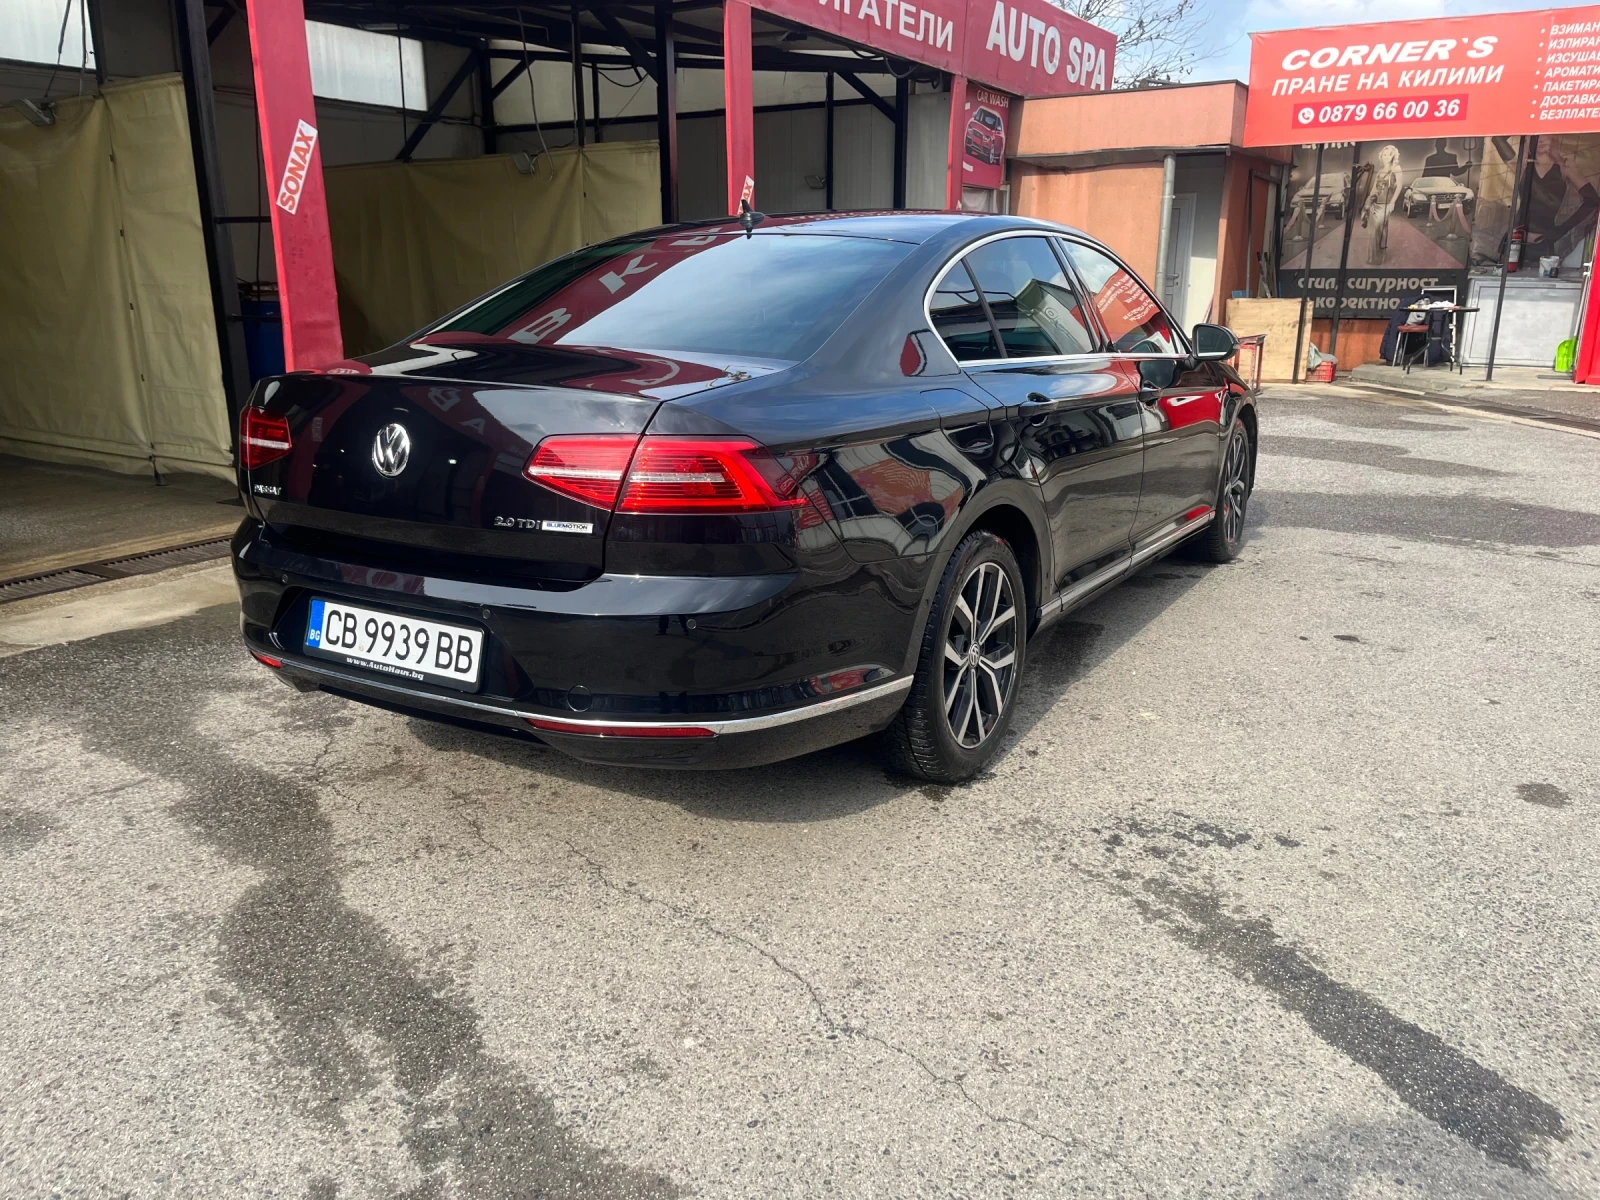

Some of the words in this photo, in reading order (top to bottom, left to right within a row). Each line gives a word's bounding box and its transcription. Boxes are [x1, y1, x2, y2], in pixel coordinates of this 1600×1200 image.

[986, 0, 1061, 75] AUTO
[1066, 36, 1106, 91] SPA
[1271, 74, 1351, 97] ПРАНЕ
[1356, 71, 1390, 91] НА
[1398, 65, 1505, 89] КИЛИМИ
[977, 90, 988, 104] CAR
[989, 93, 1010, 109] WASH
[1318, 103, 1368, 124] 0879
[1372, 101, 1398, 120] 66
[1402, 100, 1429, 119] 00
[1433, 98, 1461, 117] 36
[280, 127, 315, 211] SONAX
[1347, 277, 1439, 293] сигурност
[517, 518, 541, 530] TDI
[309, 628, 321, 641] BG
[325, 609, 358, 649] CB
[364, 617, 430, 665] 9939
[434, 631, 474, 674] BB
